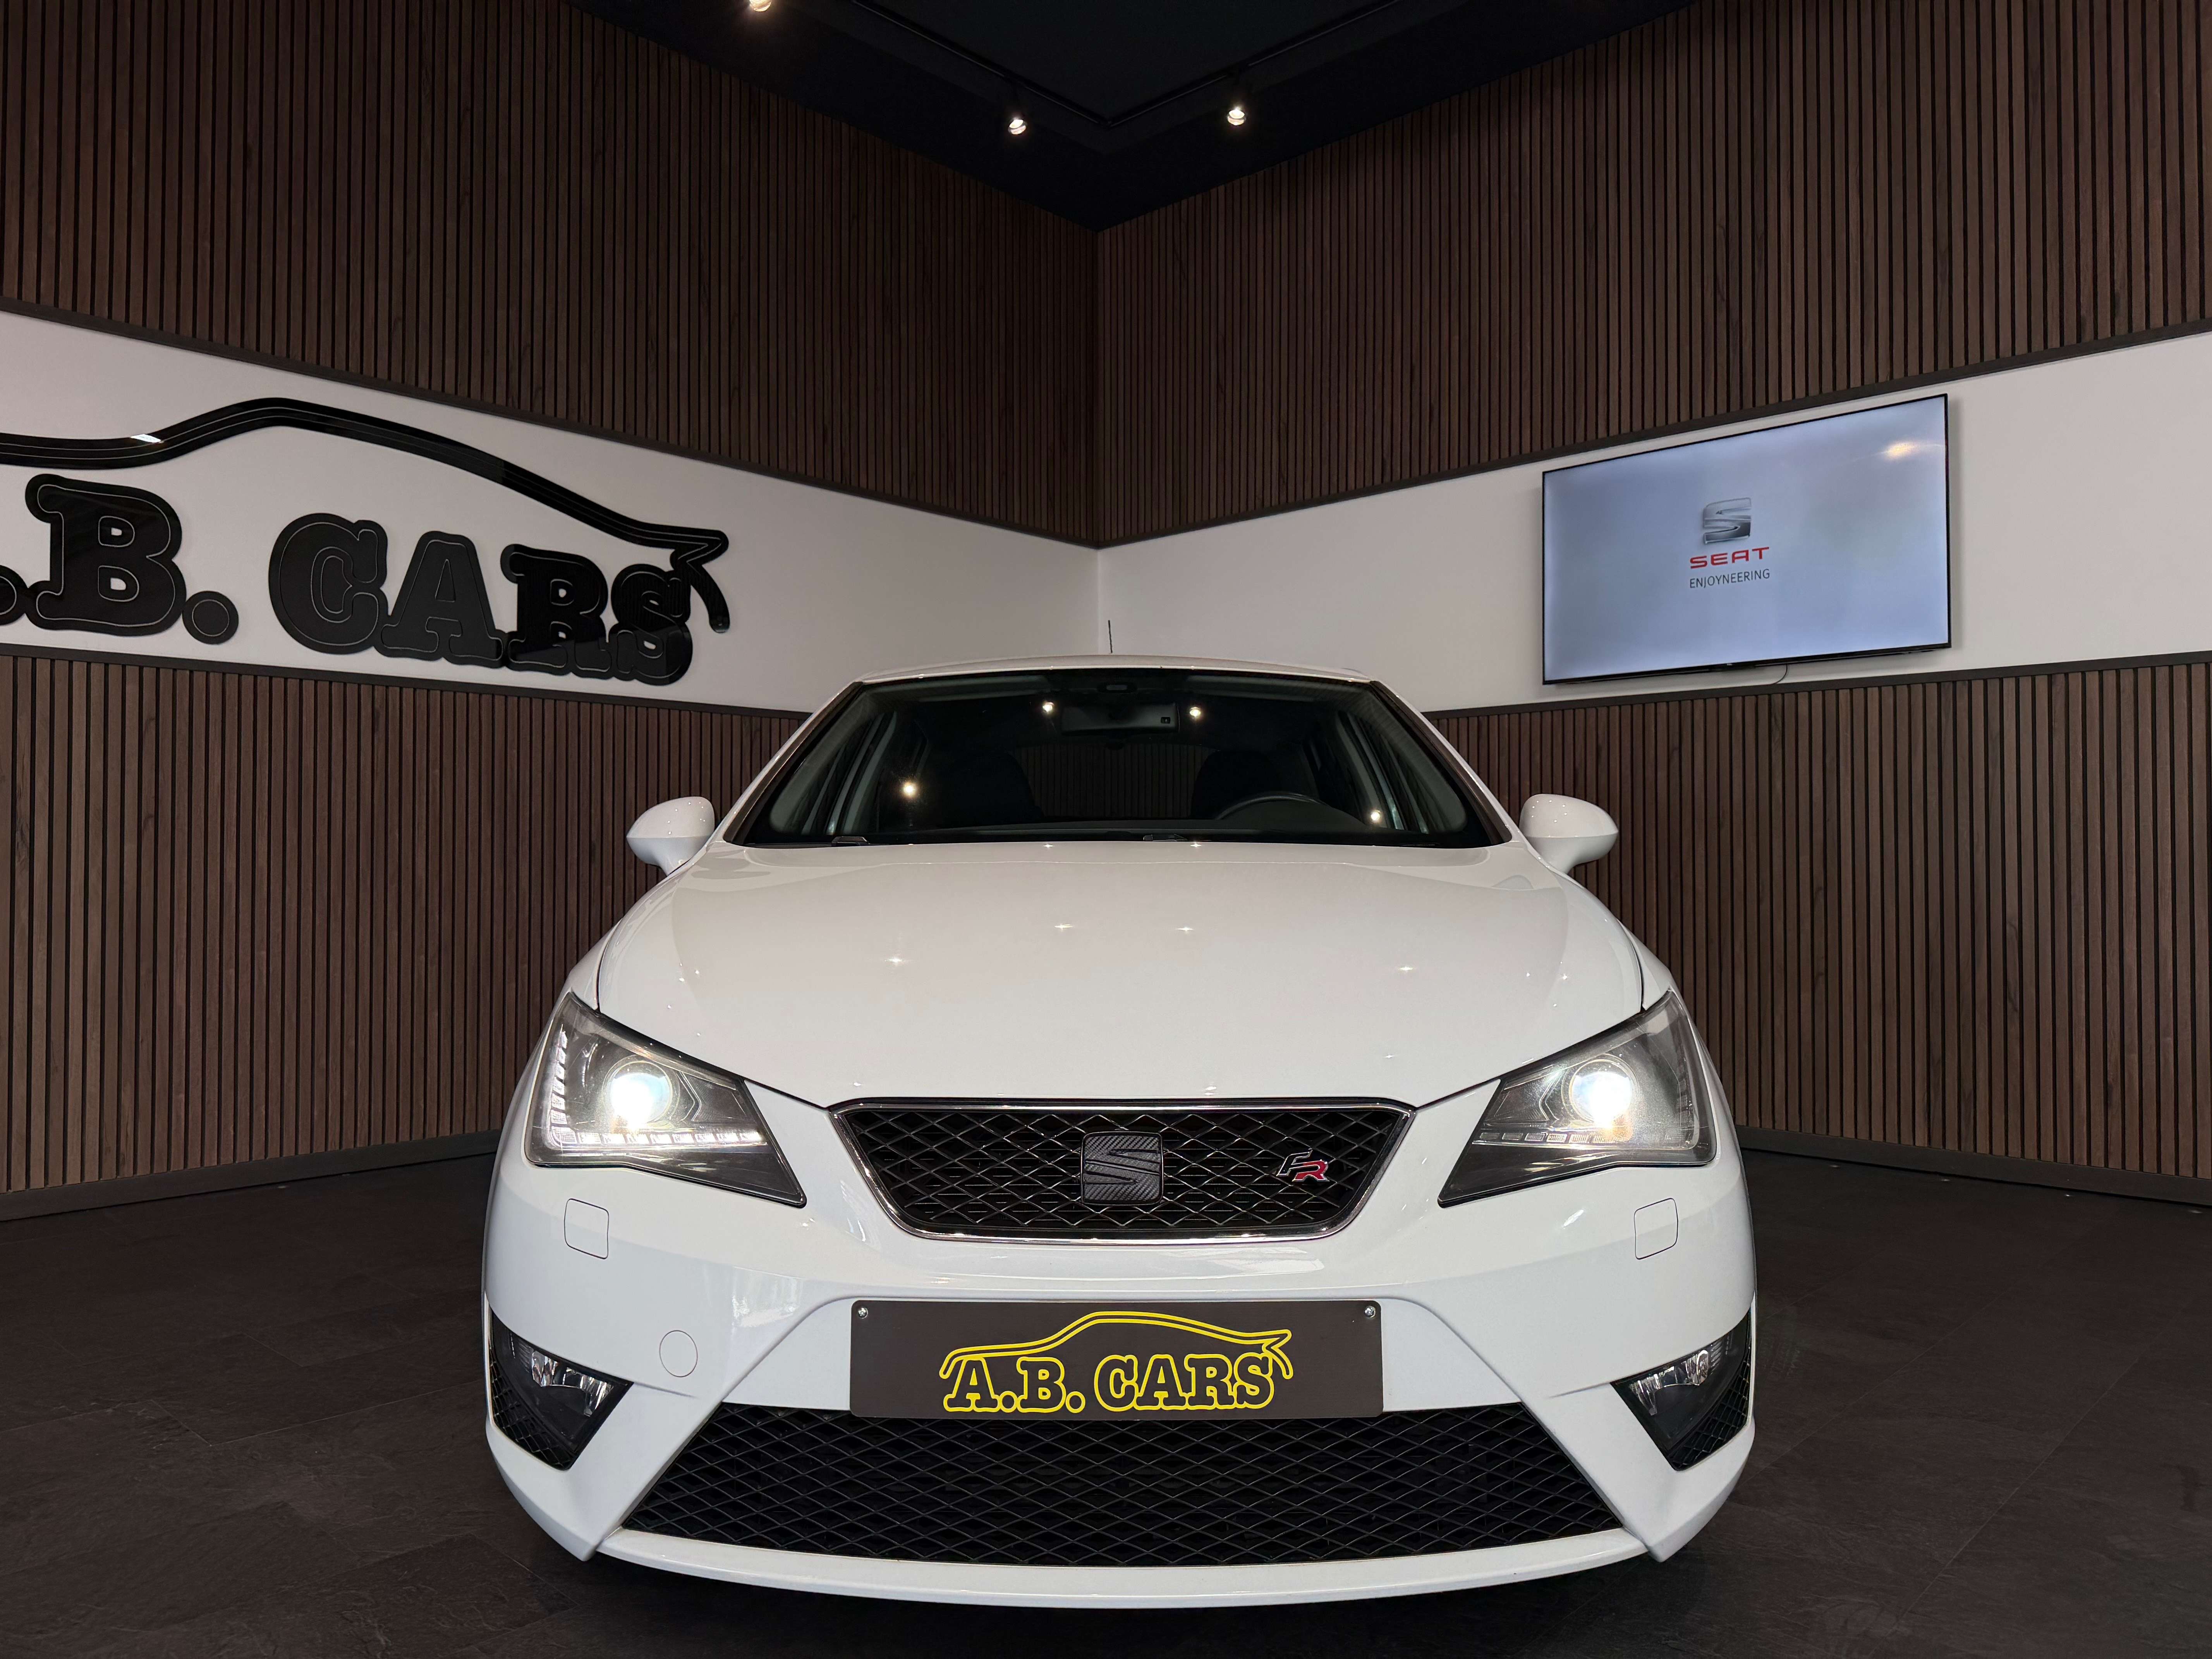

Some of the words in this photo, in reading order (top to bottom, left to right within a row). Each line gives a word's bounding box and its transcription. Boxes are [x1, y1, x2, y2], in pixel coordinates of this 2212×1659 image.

[1690, 546, 1770, 569] SEAT
[1689, 568, 1770, 588] ENJOYNEERING
[268, 513, 693, 686] CARS
[1276, 1147, 1330, 1182] FR
[943, 1355, 1085, 1413] A.B.
[1094, 1352, 1274, 1412] CARS
